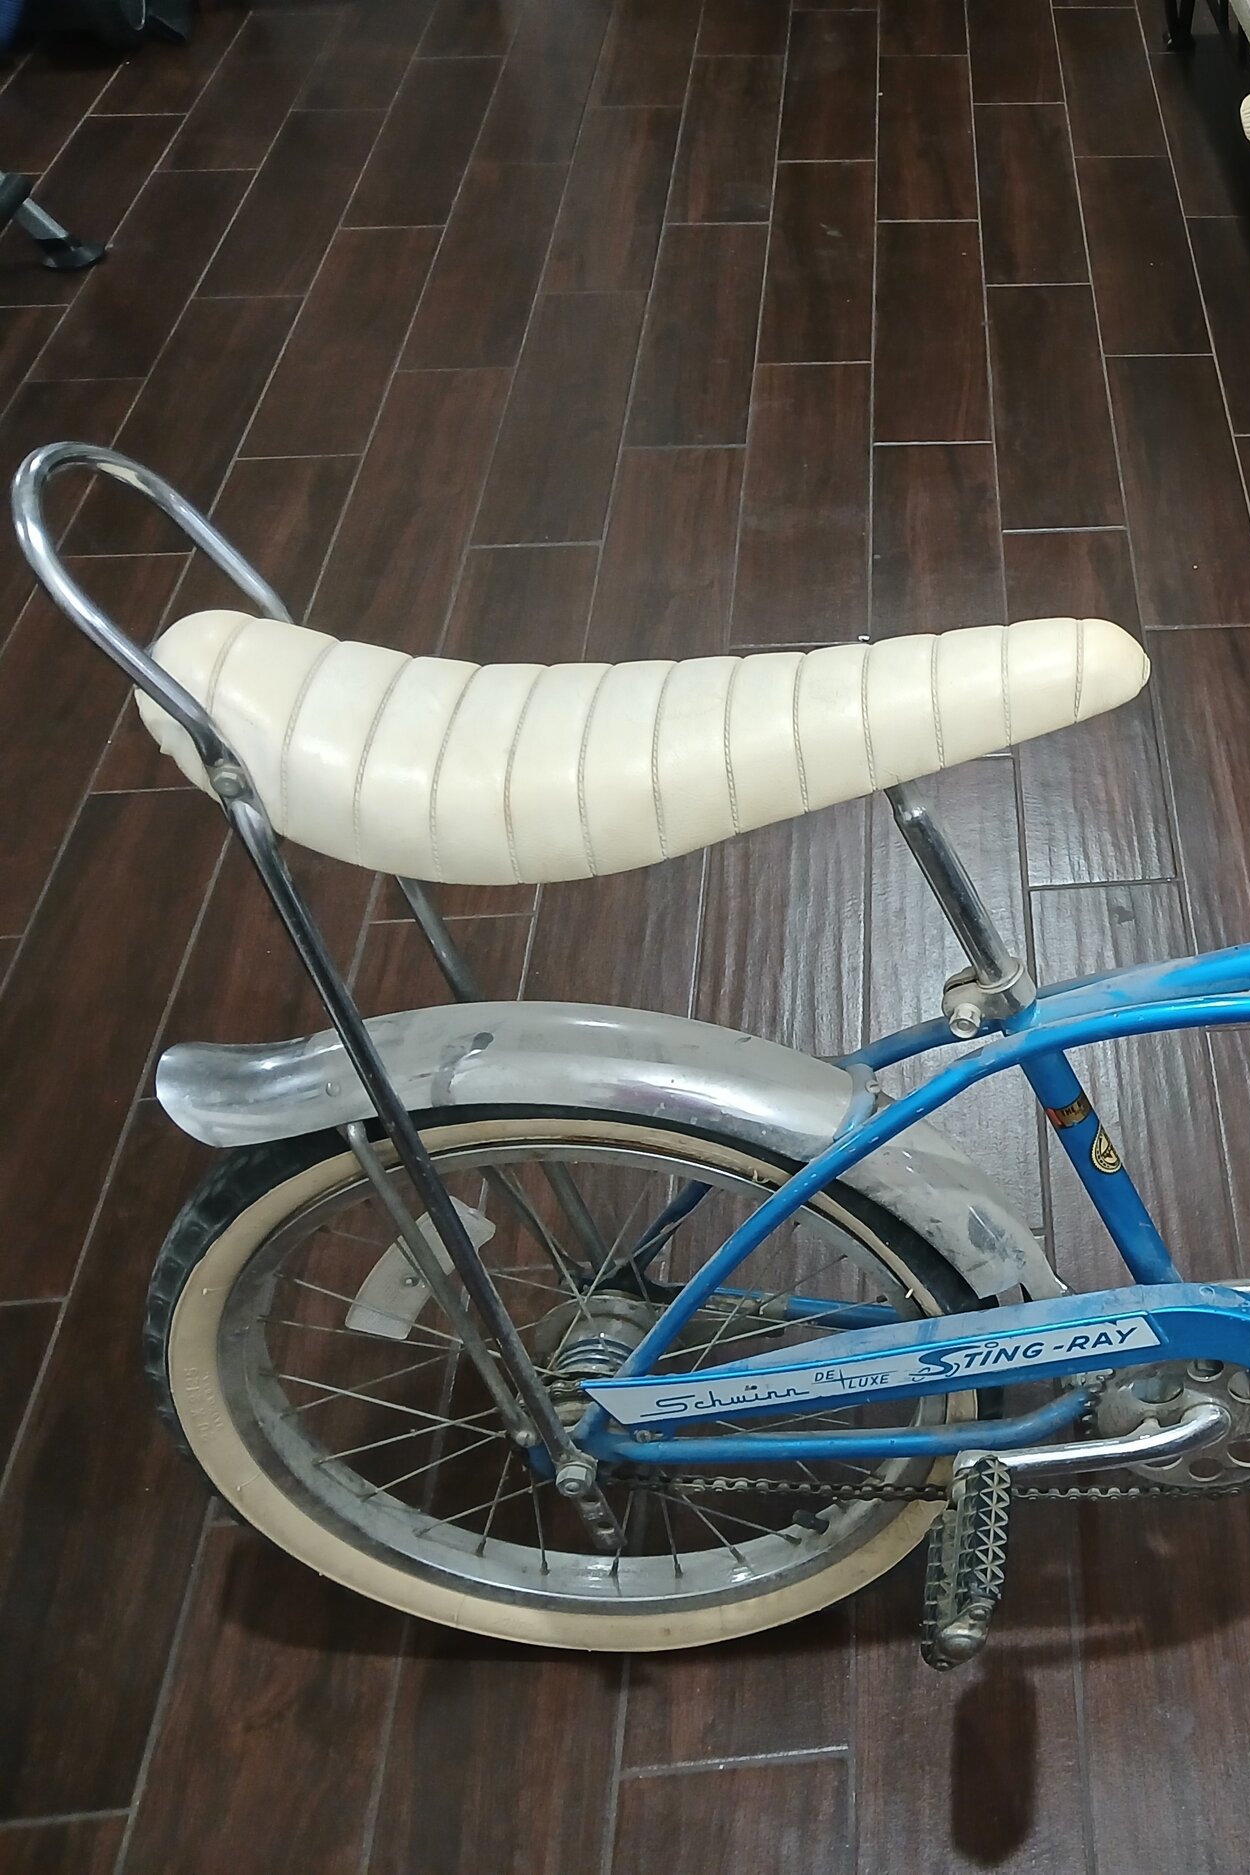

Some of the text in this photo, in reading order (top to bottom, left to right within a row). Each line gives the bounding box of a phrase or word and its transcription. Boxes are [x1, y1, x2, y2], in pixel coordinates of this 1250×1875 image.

[640, 1384, 810, 1418] Schwinn
[814, 1369, 836, 1383] DE
[847, 1373, 890, 1390] LUXE
